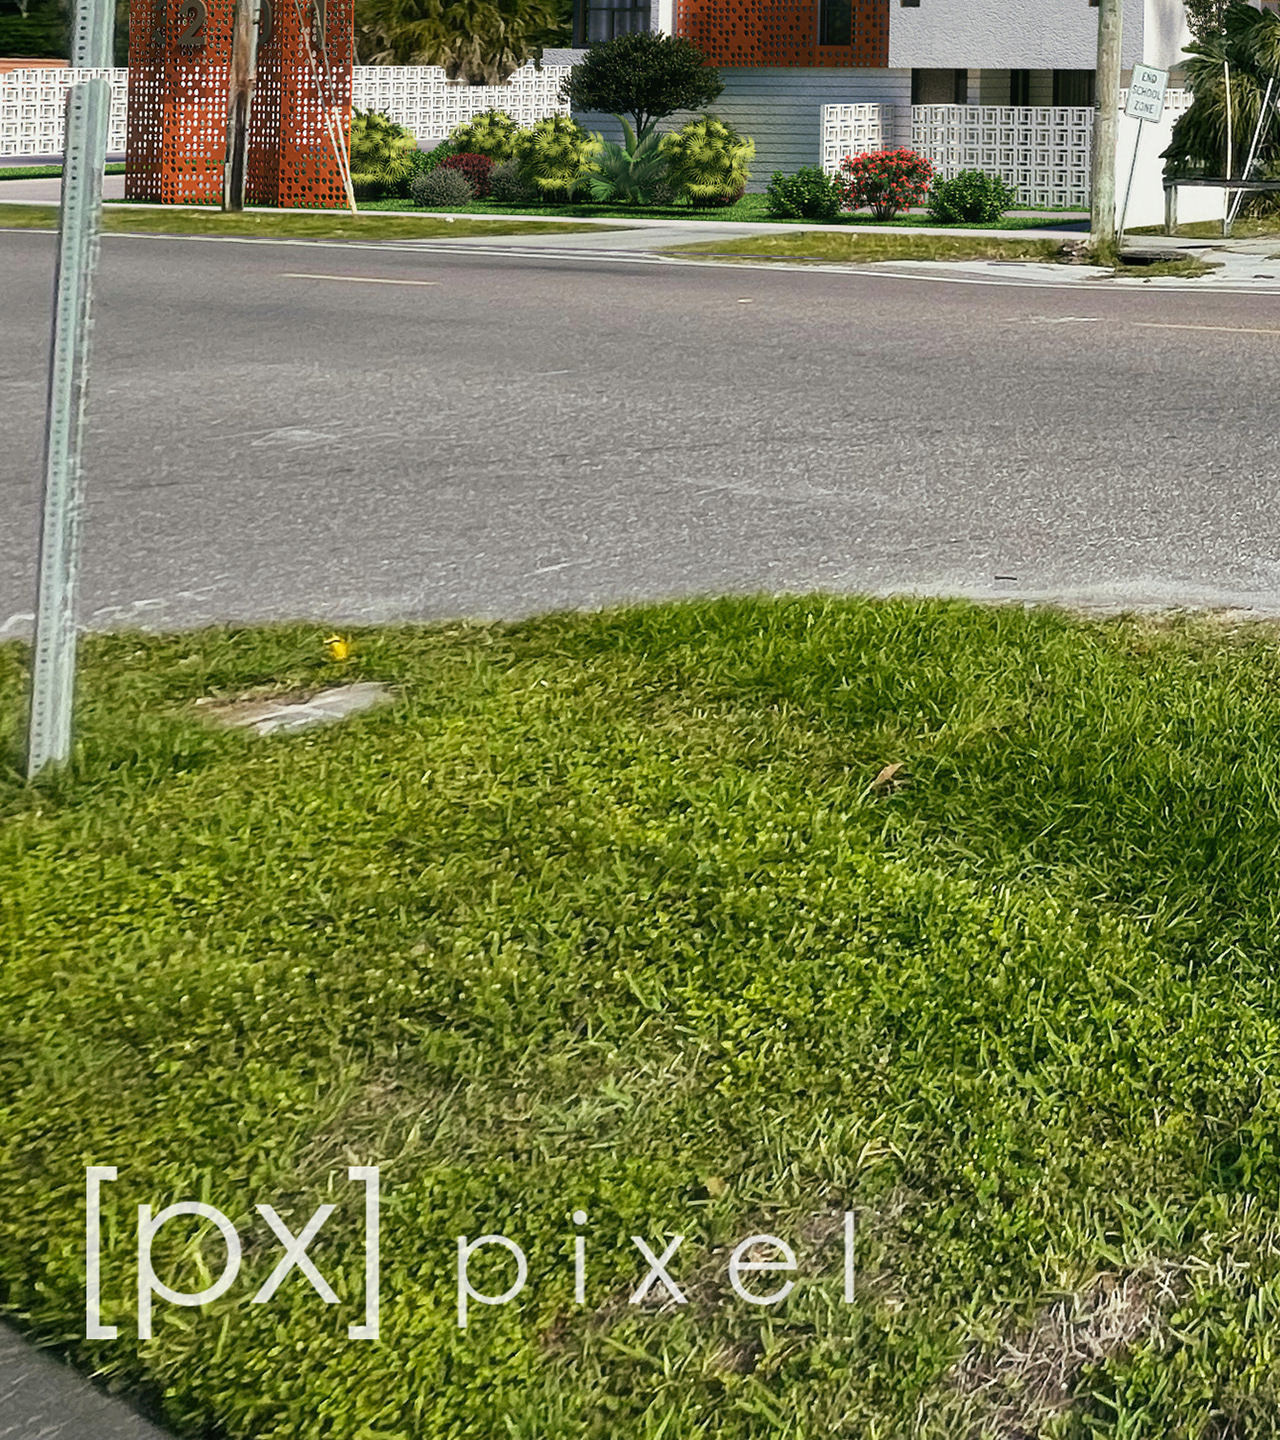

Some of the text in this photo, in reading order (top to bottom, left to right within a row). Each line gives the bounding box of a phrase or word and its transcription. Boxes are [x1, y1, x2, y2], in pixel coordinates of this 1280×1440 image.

[1142, 72, 1157, 83] END
[1132, 85, 1160, 100] SCHOOL
[1134, 101, 1154, 113] ZONE
